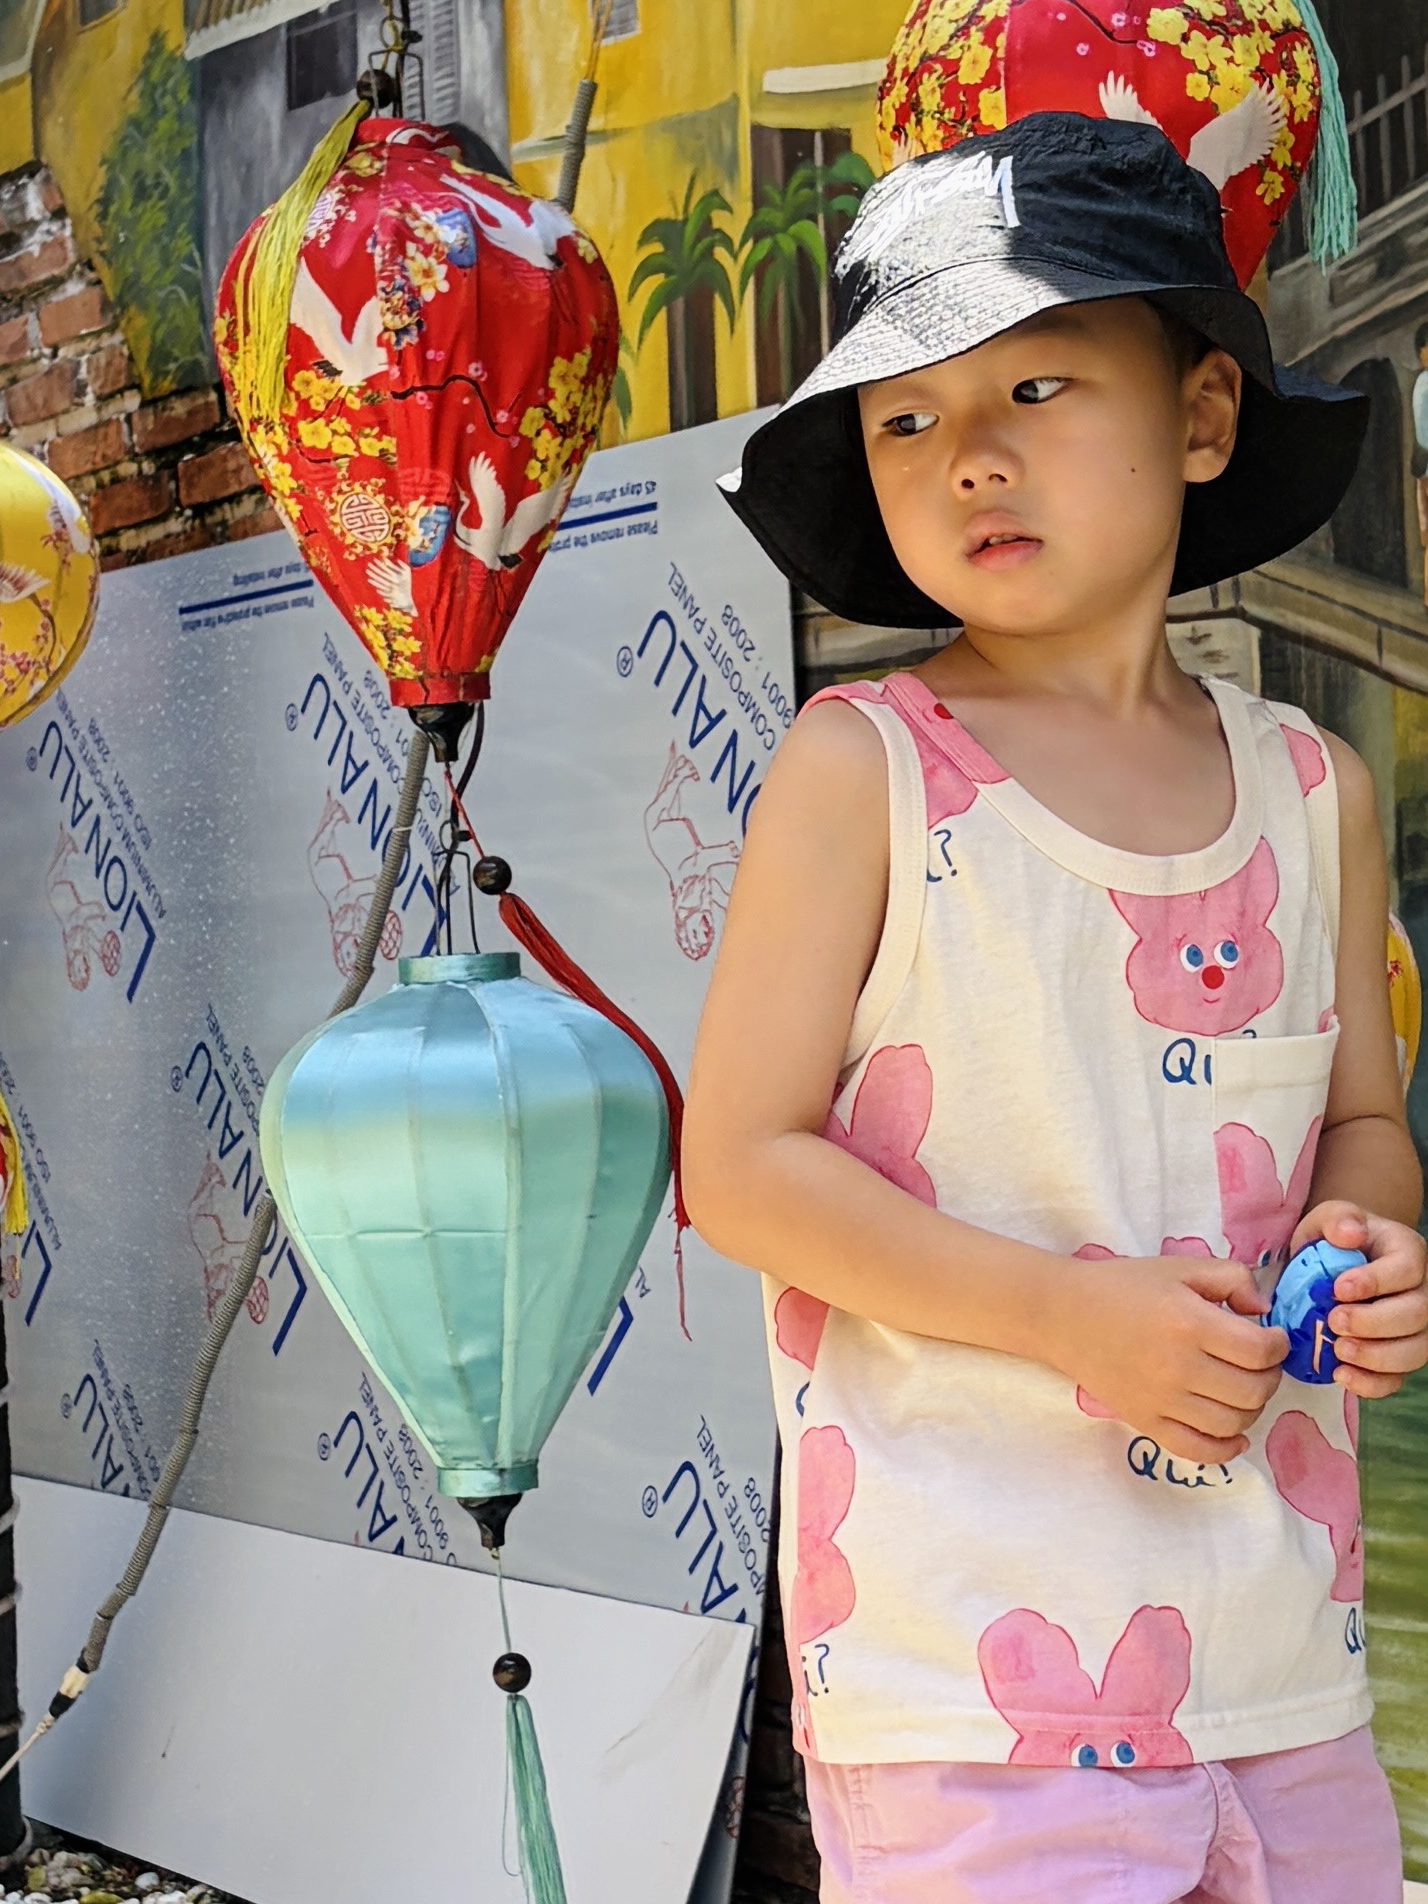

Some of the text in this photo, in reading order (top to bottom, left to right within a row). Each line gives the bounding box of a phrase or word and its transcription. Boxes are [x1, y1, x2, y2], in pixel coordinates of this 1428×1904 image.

[668, 561, 707, 635] PANEL
[721, 604, 756, 662] 2008
[323, 631, 353, 695] PANEL
[703, 627, 776, 751] COMPOSITE
[696, 1414, 730, 1499] PANEL
